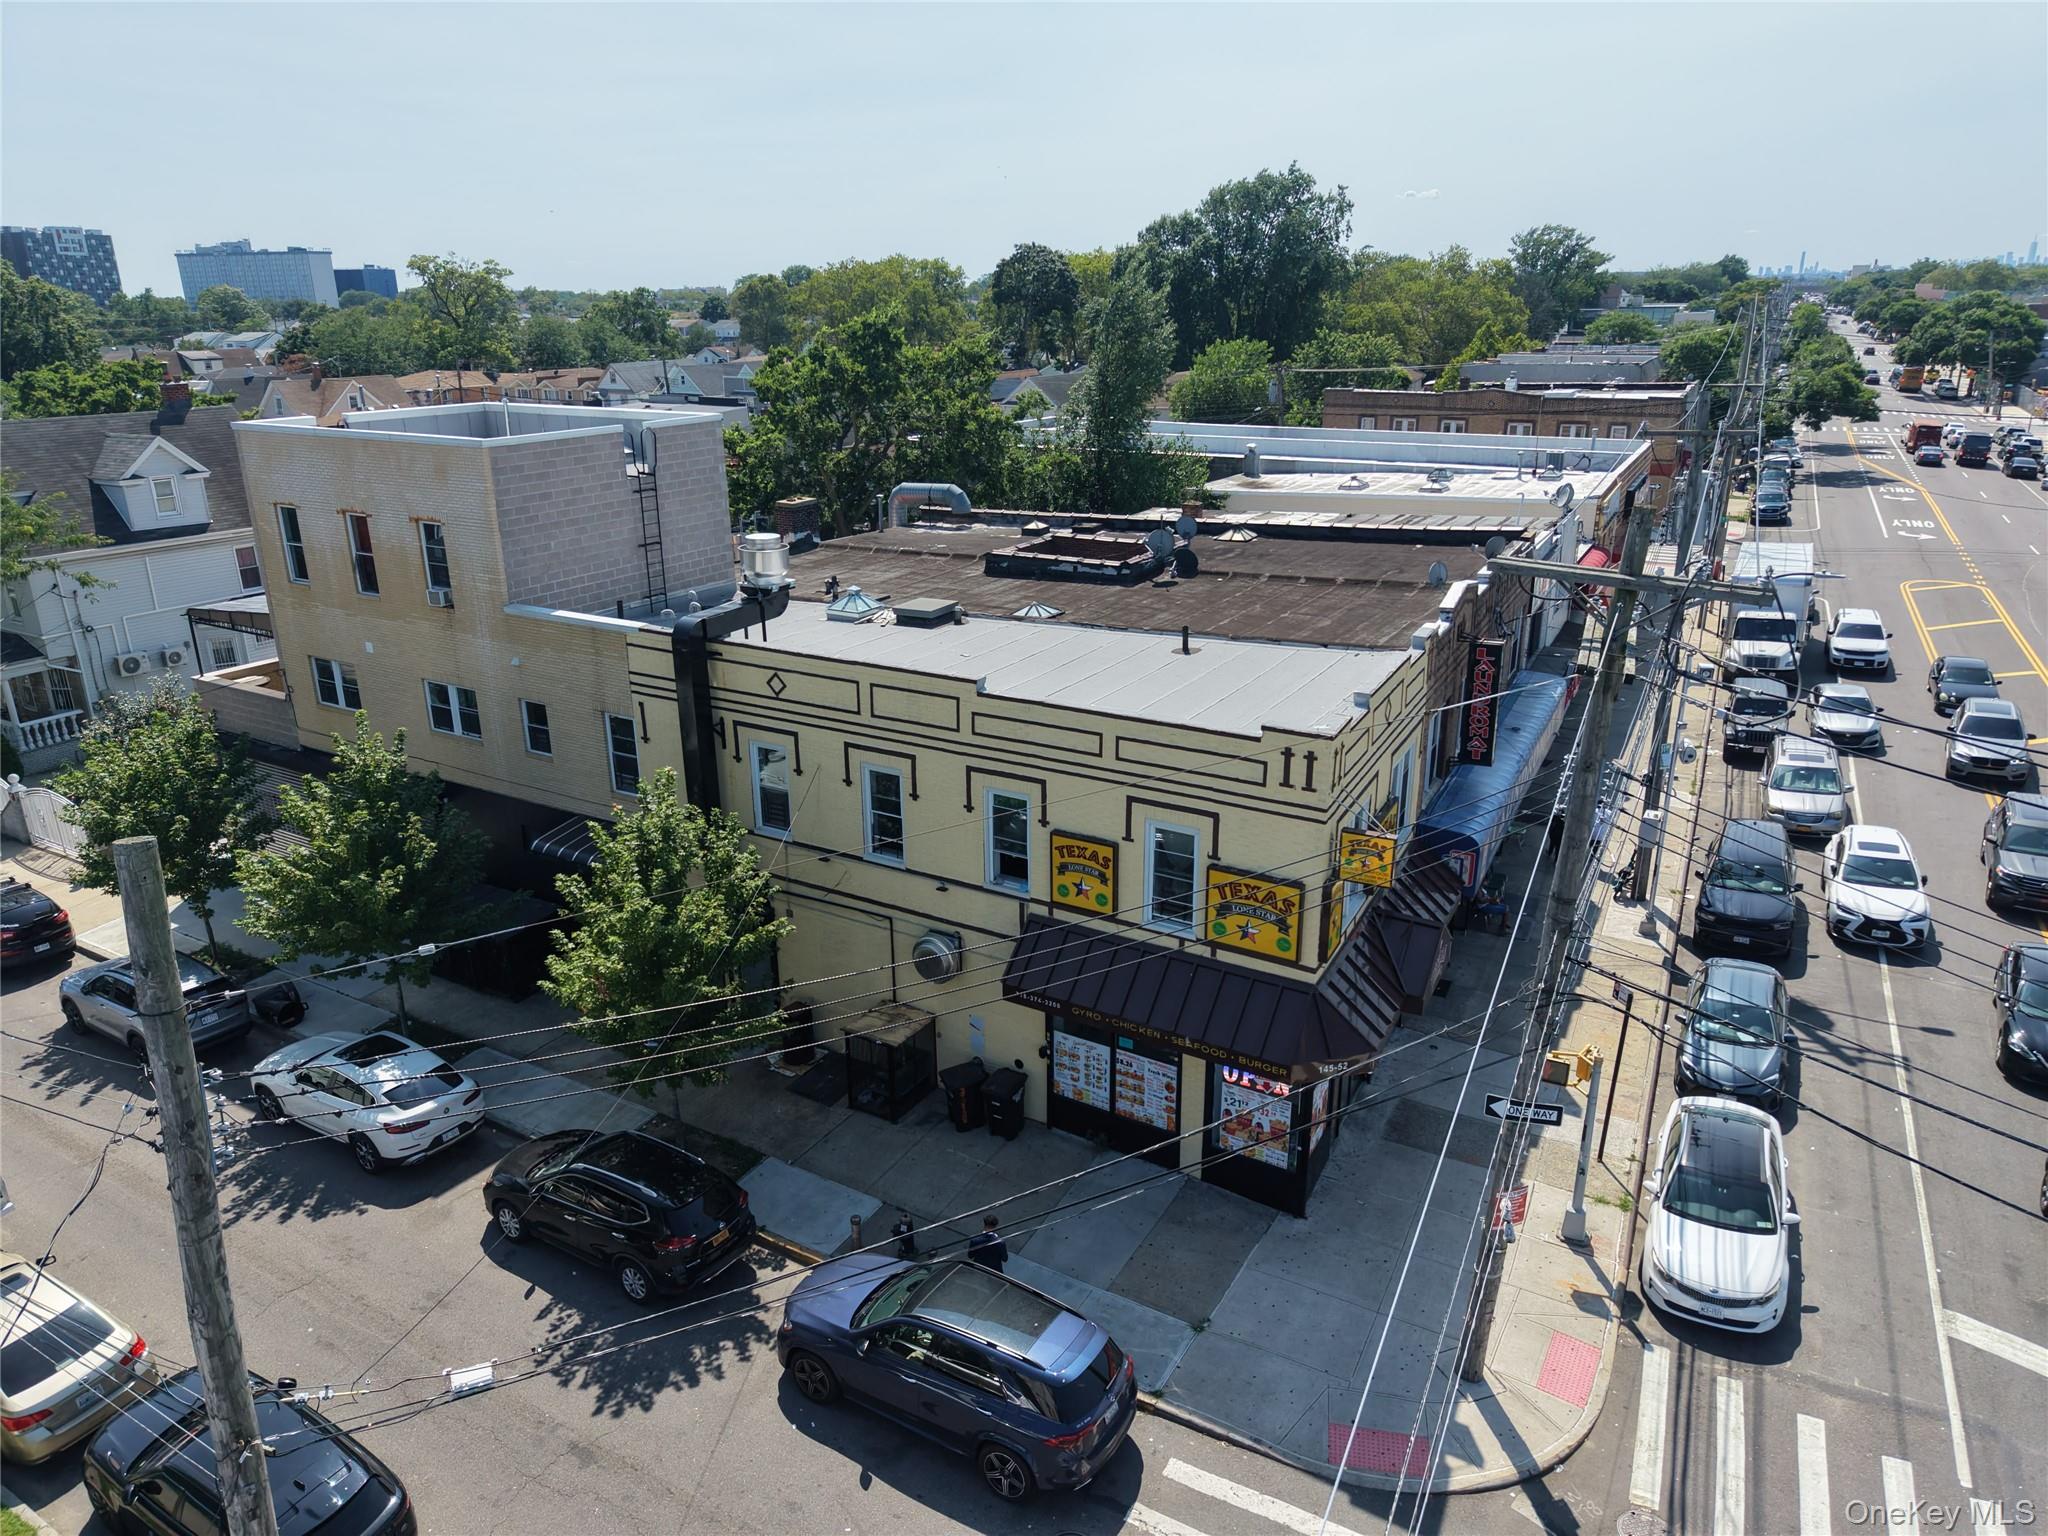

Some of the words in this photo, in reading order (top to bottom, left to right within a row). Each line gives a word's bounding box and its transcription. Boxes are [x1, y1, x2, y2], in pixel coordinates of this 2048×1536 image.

[1892, 519, 1935, 528] ONLY
[1466, 647, 1496, 760] LAUNDROMAT
[1054, 844, 1112, 870] TEXAS
[1068, 863, 1084, 873] LONE
[1084, 866, 1099, 876] STAR
[1214, 882, 1297, 916] TEXAS
[1232, 904, 1255, 916] LONE
[1255, 909, 1277, 922] STAR
[1071, 1007, 1101, 1021] GYRO
[1112, 1018, 1161, 1040] CHICKEN
[1171, 1036, 1228, 1059] SEAFOOD
[1238, 1056, 1289, 1077] BURGER
[1318, 1062, 1349, 1074] 145-52
[1507, 1106, 1531, 1117] ONE
[1533, 1110, 1554, 1121] WAY
